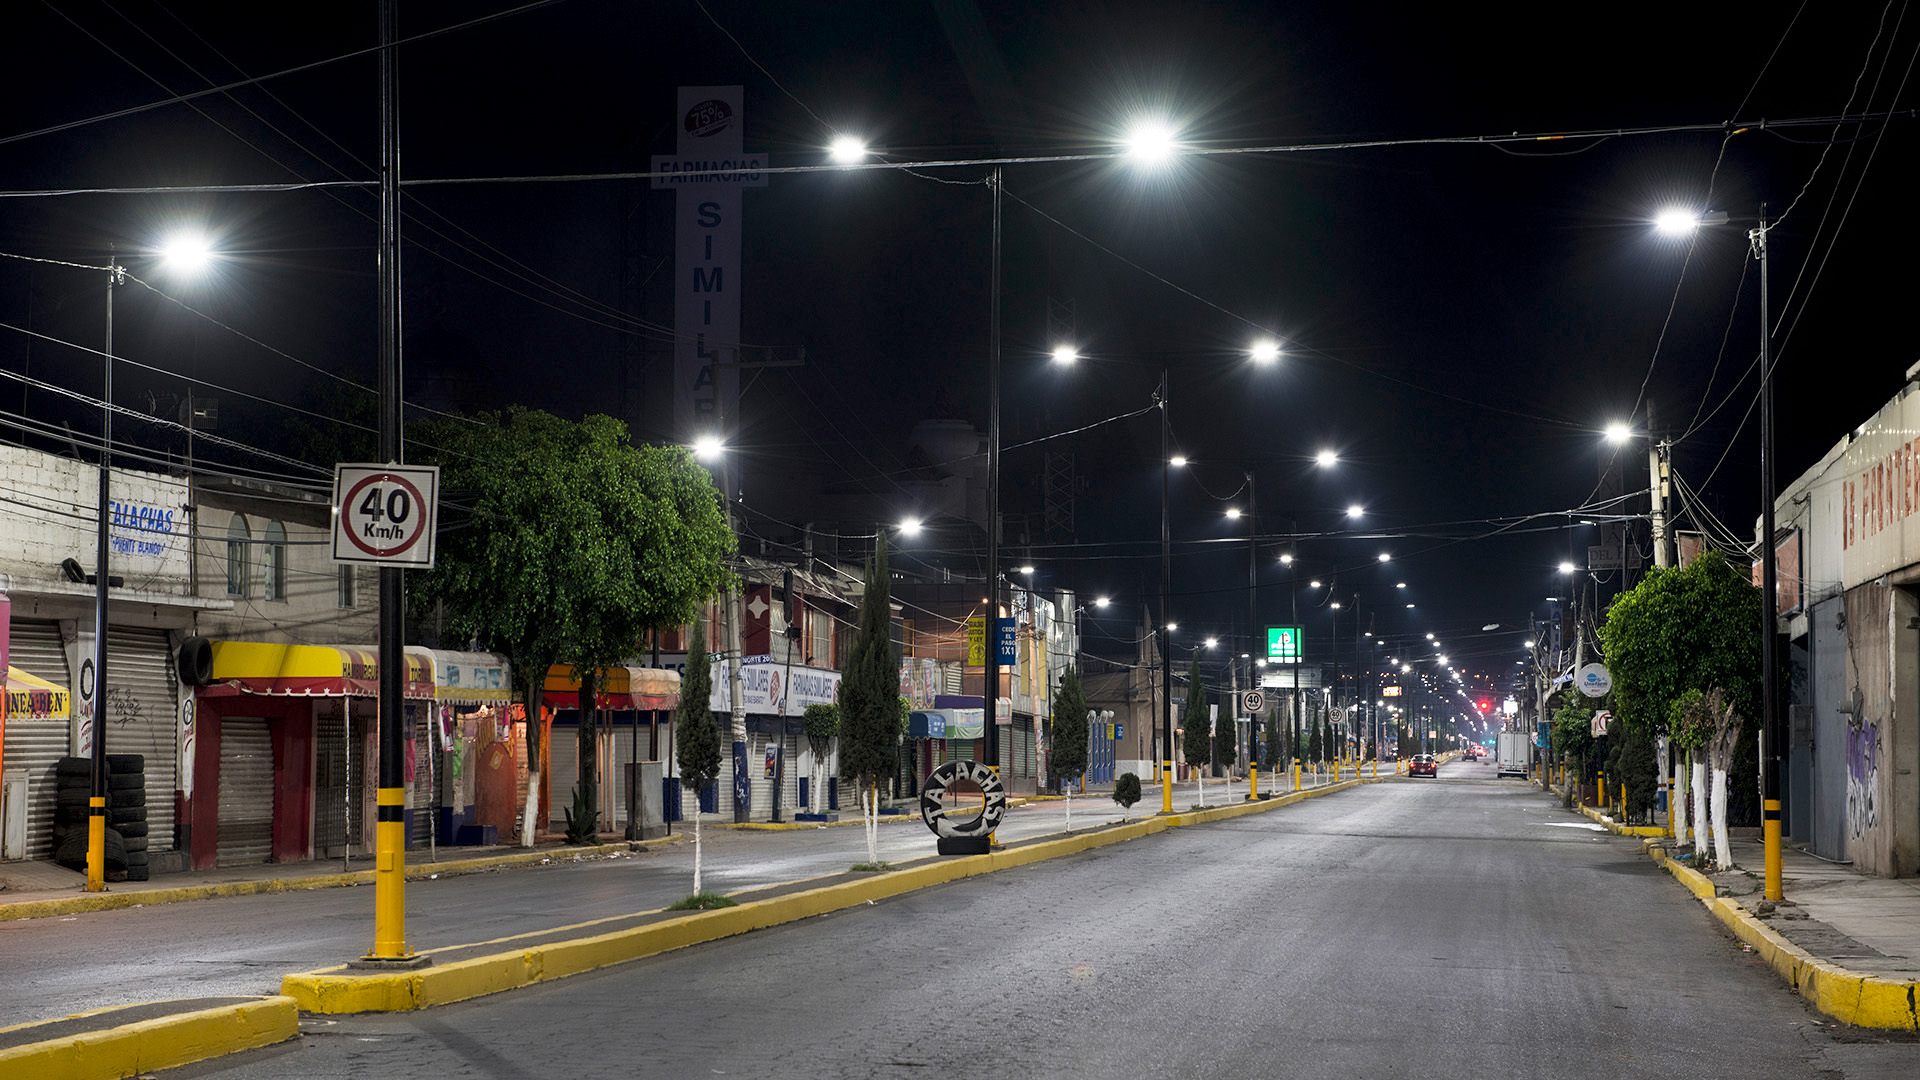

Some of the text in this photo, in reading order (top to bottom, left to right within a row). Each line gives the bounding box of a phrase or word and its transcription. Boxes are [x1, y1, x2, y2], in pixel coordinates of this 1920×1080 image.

[691, 104, 724, 128] 75%
[660, 159, 761, 184] FARMACIAS
[693, 201, 723, 418] SIMILAR
[360, 487, 411, 524] 40
[363, 522, 404, 540] Km/h
[742, 654, 770, 664] NORTE 20
[1001, 646, 1014, 655] 1X1
[342, 662, 379, 680] HAMBURGUE
[1247, 695, 1259, 704] 40
[924, 761, 1005, 825] TALACHAS
